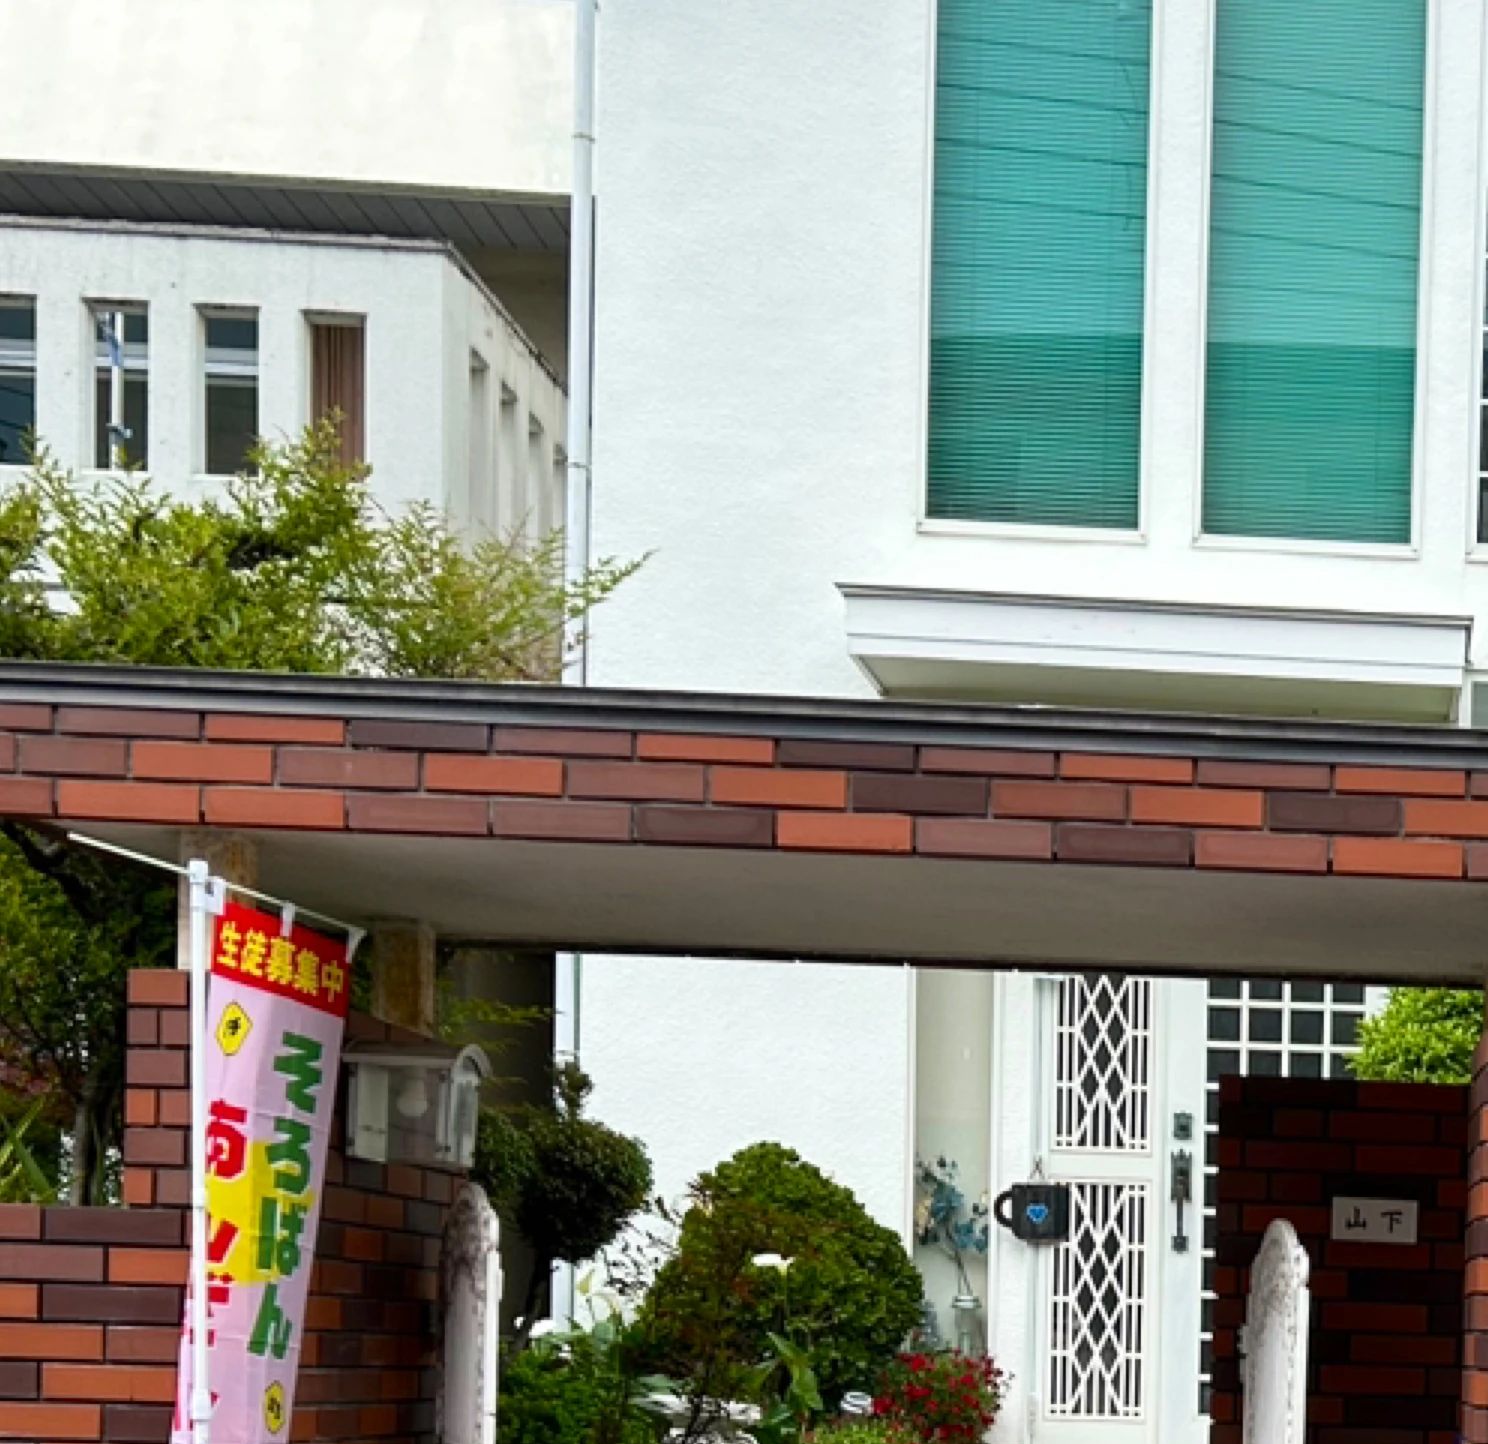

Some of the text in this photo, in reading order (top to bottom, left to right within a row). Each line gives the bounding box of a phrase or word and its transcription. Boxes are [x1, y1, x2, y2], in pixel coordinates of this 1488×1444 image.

[216, 920, 343, 1003] 生徒募集中
[246, 1031, 323, 1360] そろばん
[1345, 1206, 1402, 1233] 山下
